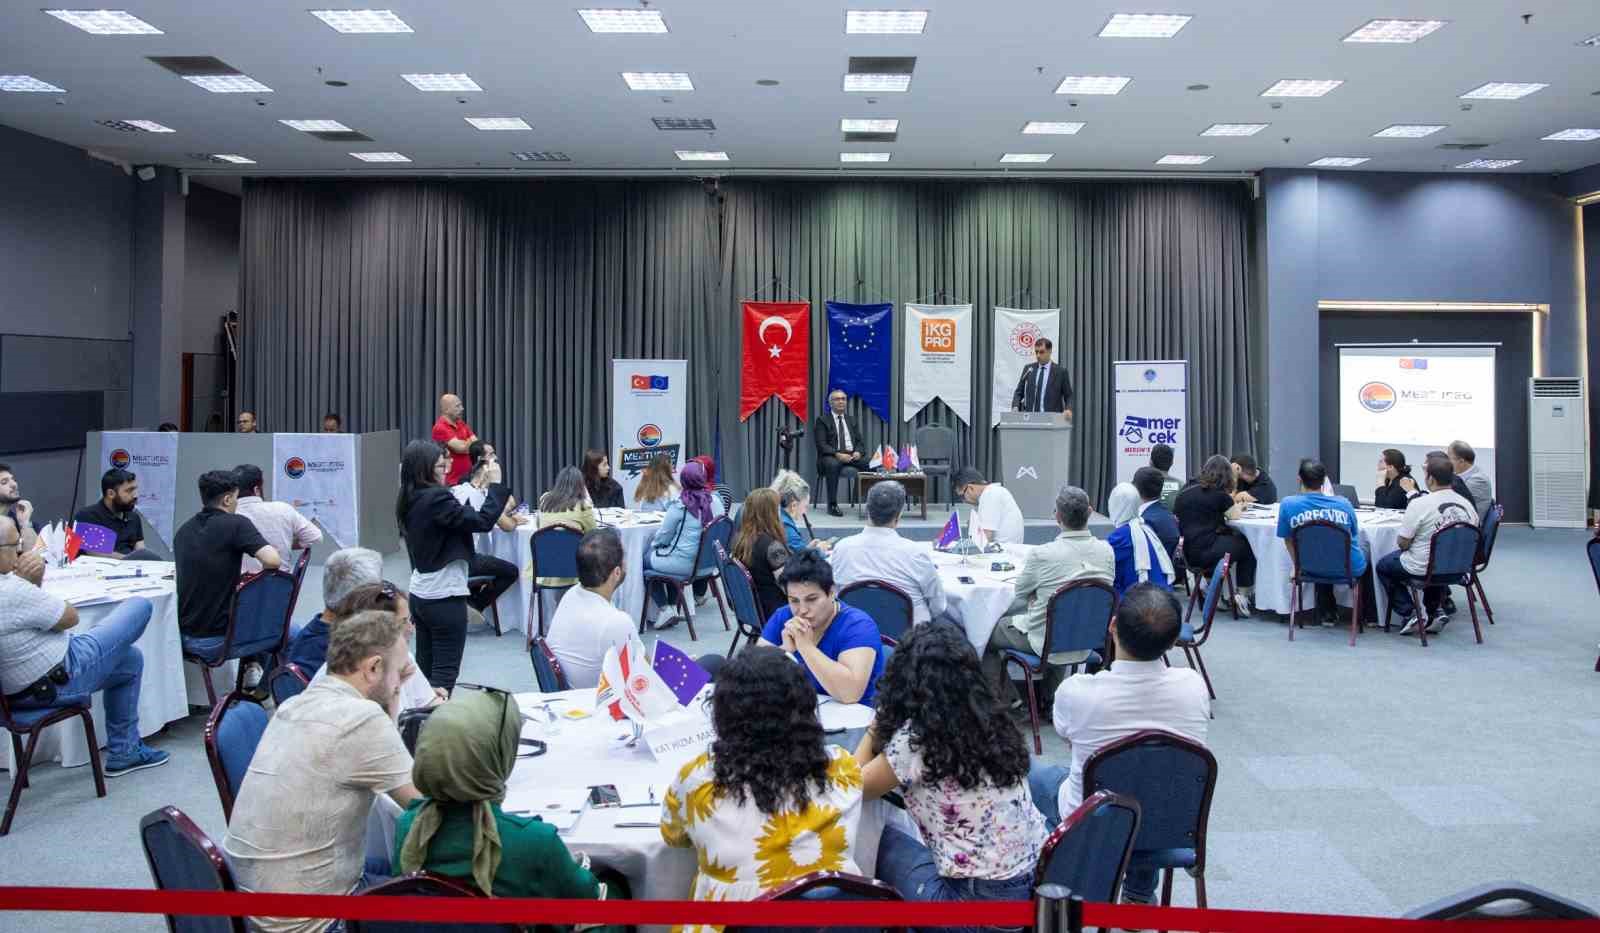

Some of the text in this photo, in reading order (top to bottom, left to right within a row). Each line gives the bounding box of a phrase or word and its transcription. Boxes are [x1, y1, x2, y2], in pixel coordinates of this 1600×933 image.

[925, 337, 952, 347] PRO
[1147, 418, 1182, 430] mer
[1148, 430, 1177, 444] cek
